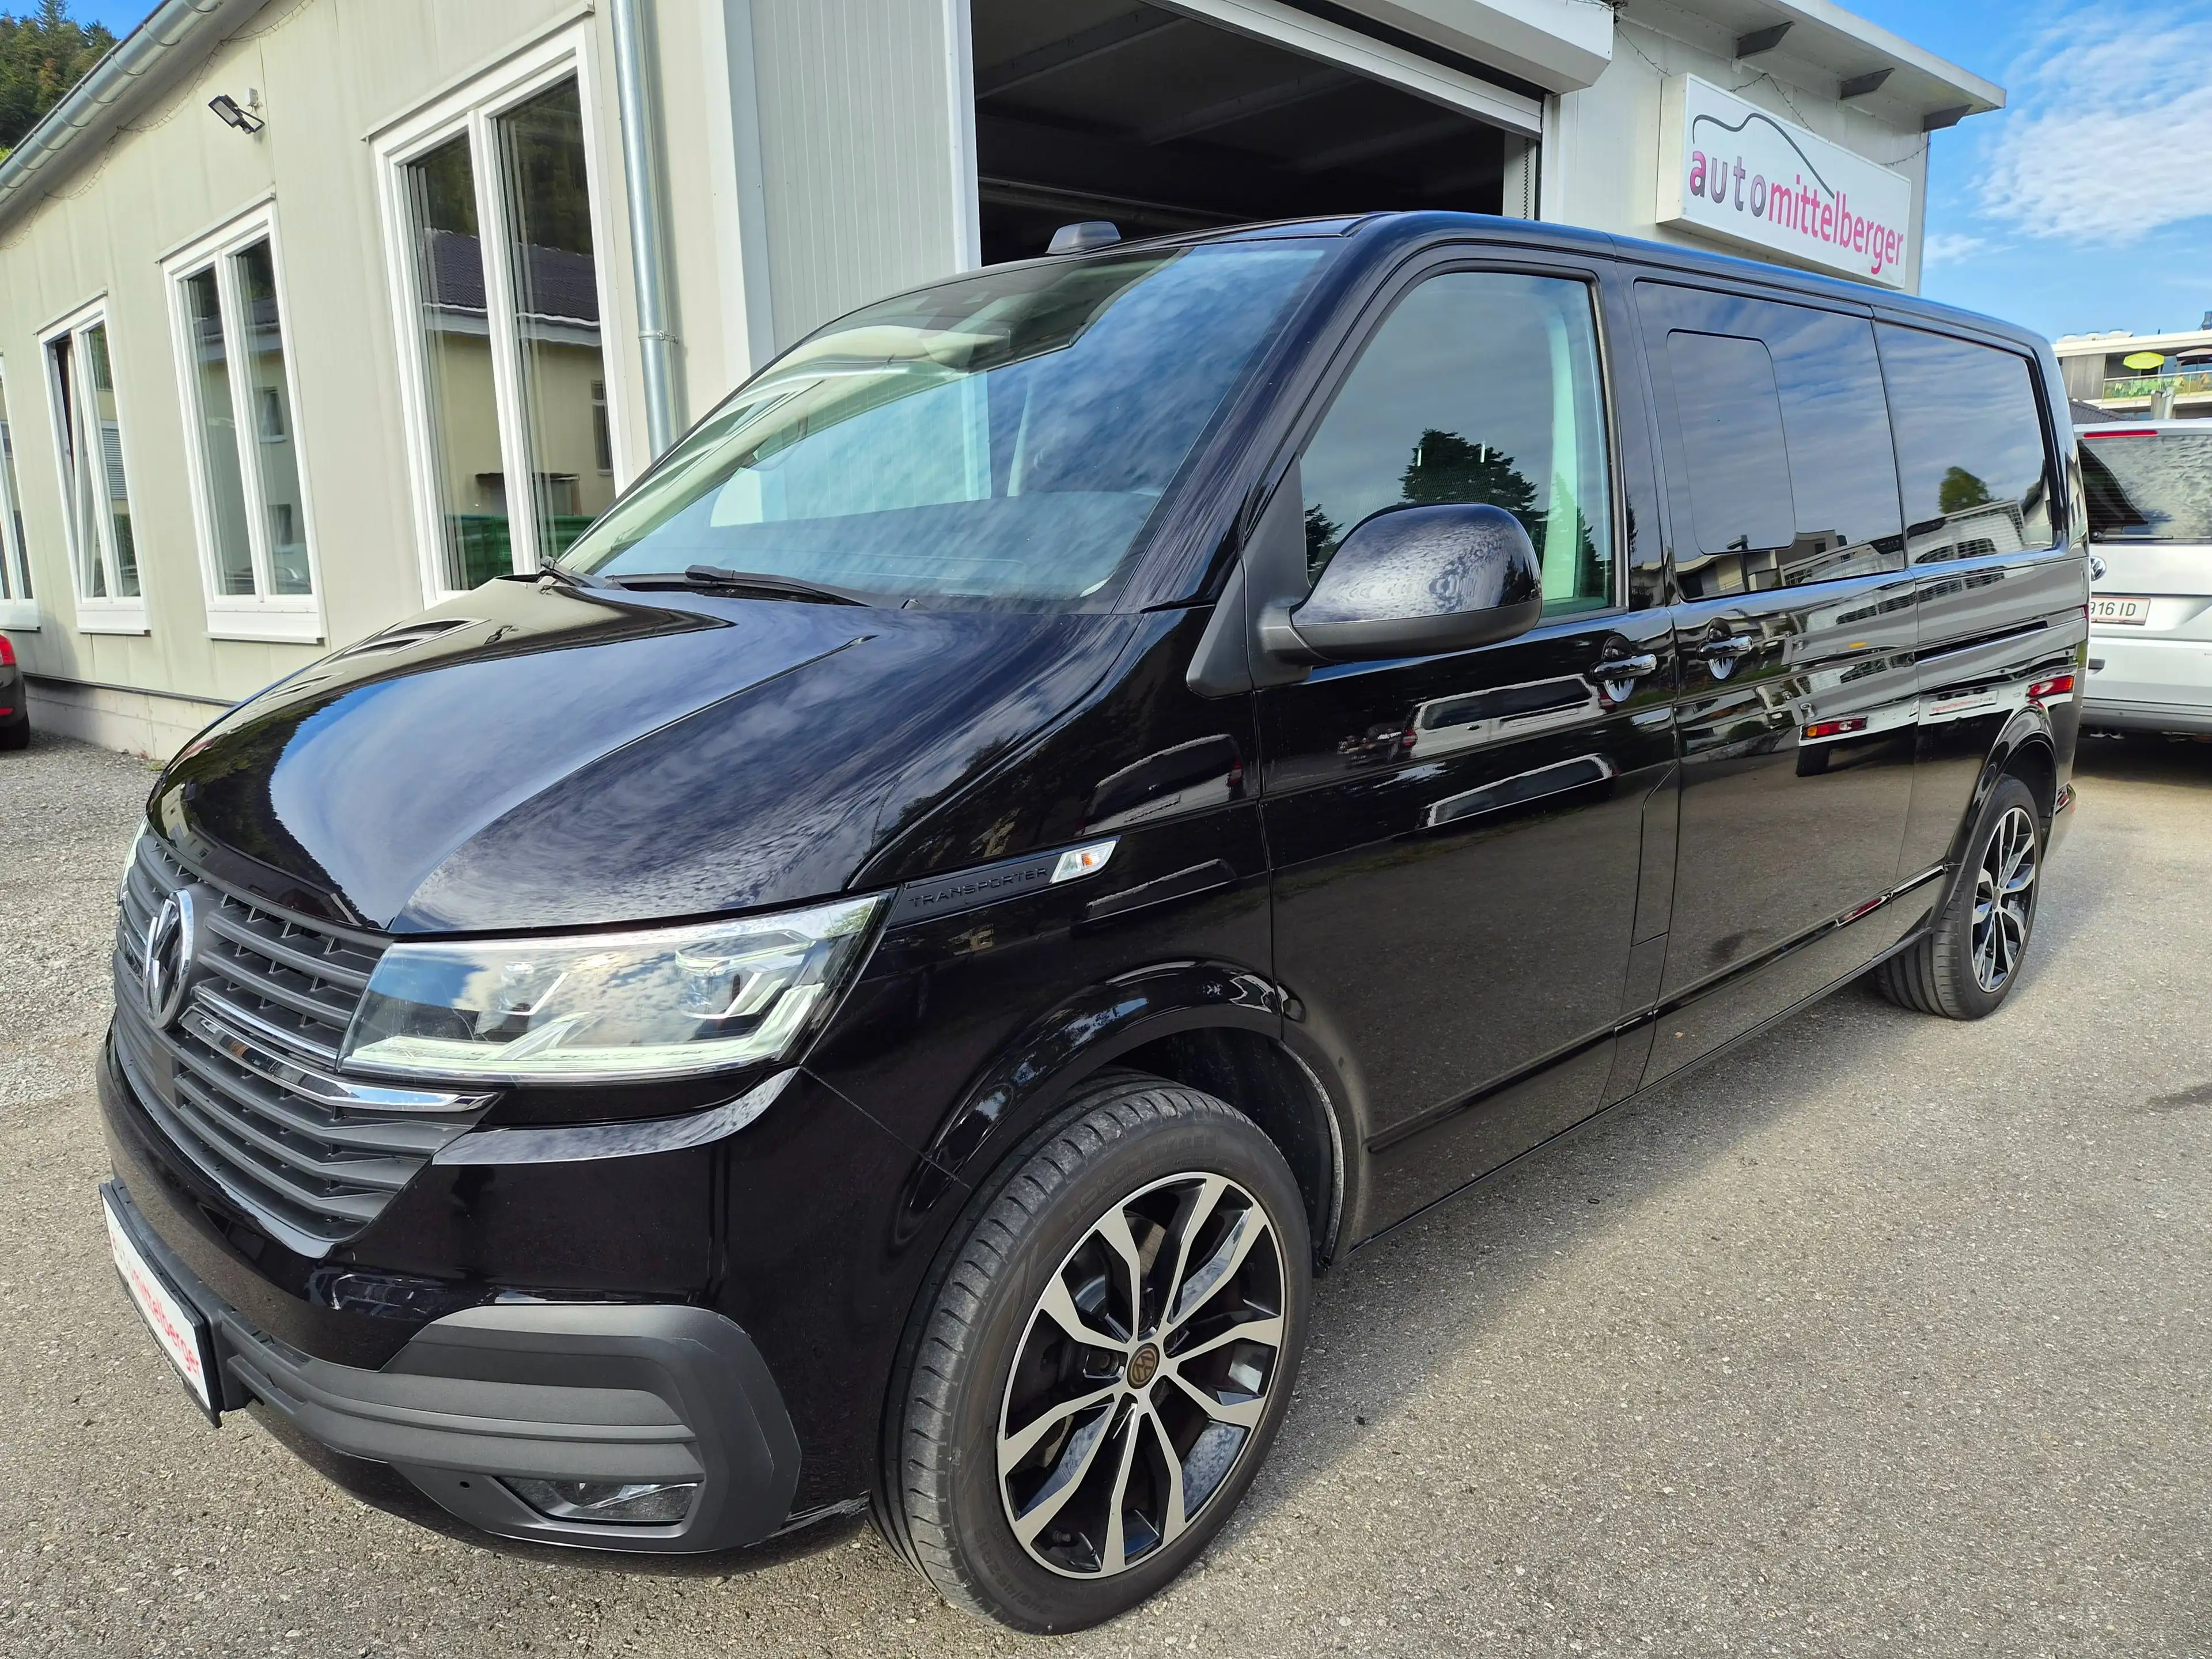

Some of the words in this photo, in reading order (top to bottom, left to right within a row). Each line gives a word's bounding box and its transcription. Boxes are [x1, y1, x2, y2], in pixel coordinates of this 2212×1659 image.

[1689, 150, 1904, 275] automittelberger
[2119, 602, 2137, 616] ID
[908, 866, 1048, 907] TRANSPORTER
